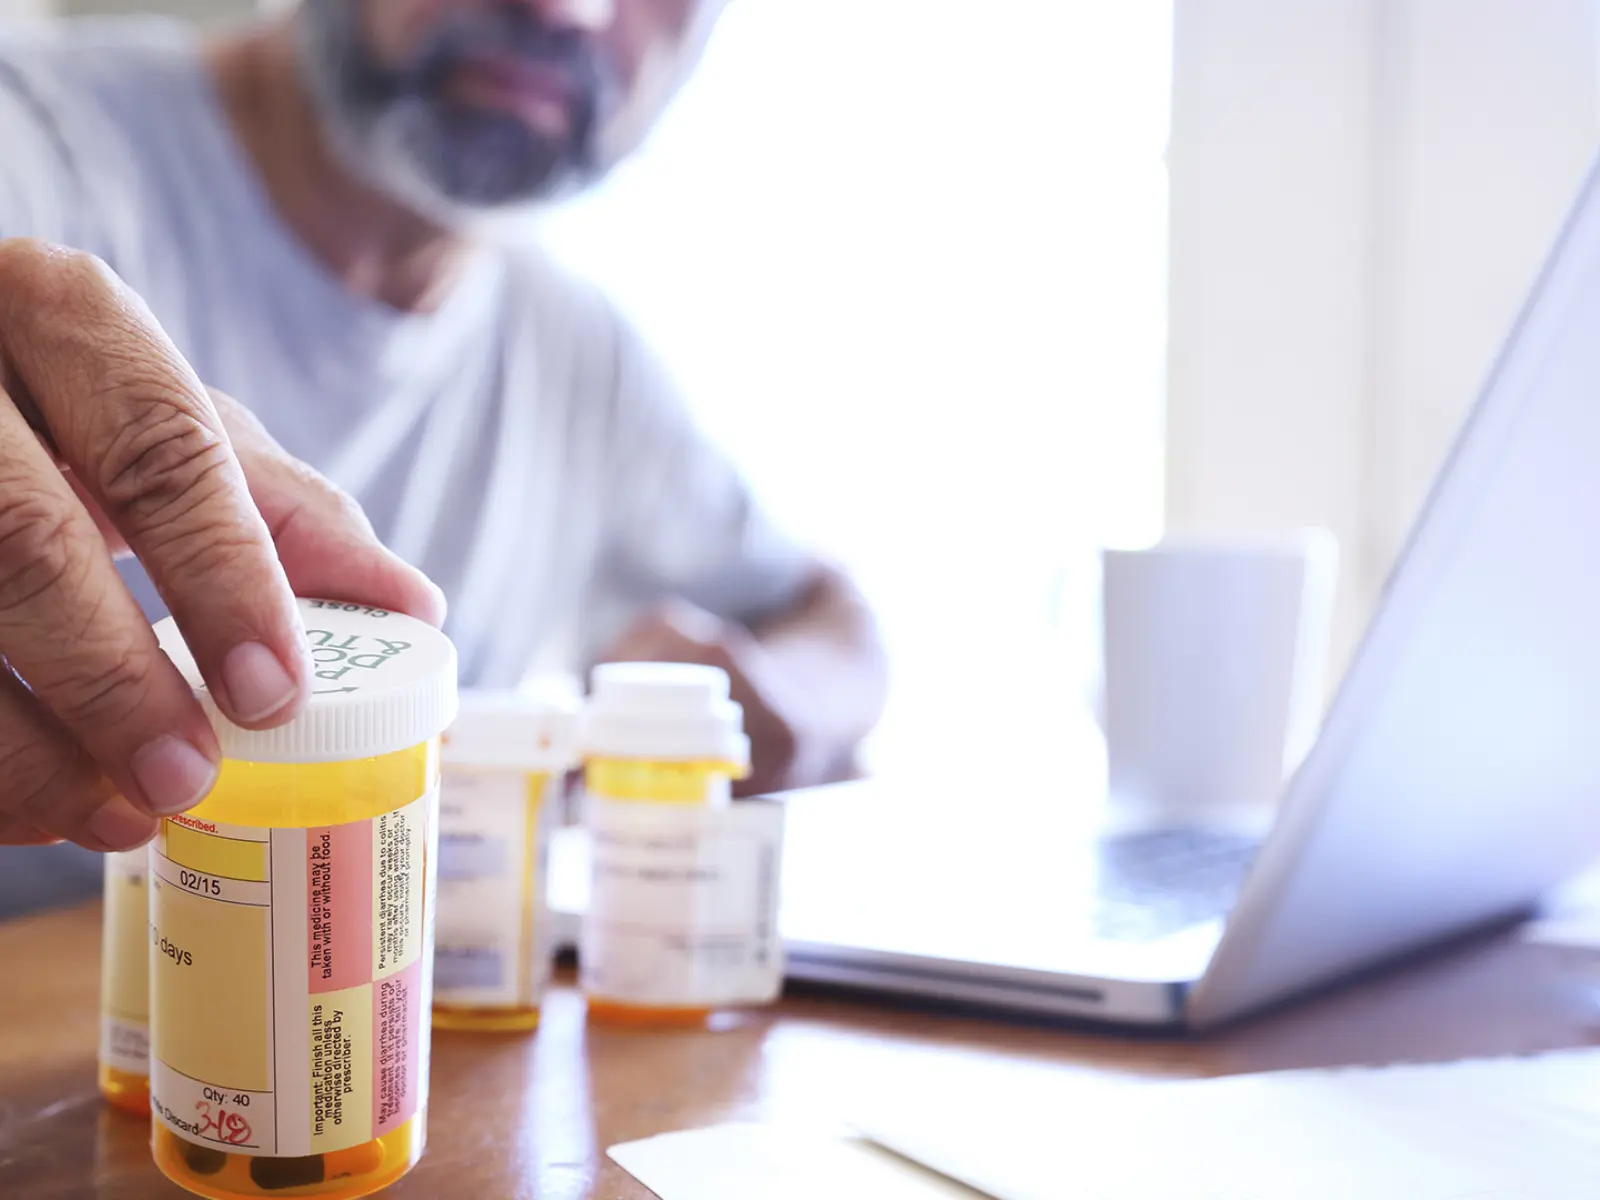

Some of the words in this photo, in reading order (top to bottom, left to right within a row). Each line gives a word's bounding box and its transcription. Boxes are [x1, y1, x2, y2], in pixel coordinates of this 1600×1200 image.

[309, 599, 389, 618] CLOSE
[305, 629, 361, 650] TU
[311, 647, 389, 669] DO
[379, 815, 387, 844] colitis
[310, 845, 320, 860] be
[320, 831, 331, 860] food.
[379, 847, 387, 858] to
[180, 870, 221, 895] 02/15
[311, 863, 323, 886] may
[320, 862, 331, 904] without
[379, 859, 387, 878] due
[322, 907, 331, 919] or
[379, 880, 387, 919] diarrhea
[310, 890, 321, 940] medicine
[321, 922, 332, 945] with
[378, 922, 387, 969] Persistent
[160, 936, 193, 966] days
[311, 944, 321, 968] This
[321, 948, 332, 979] taken
[379, 982, 391, 1018] during
[312, 1005, 322, 1026] this
[332, 1010, 343, 1023] by
[312, 1029, 322, 1041] all
[322, 1020, 332, 1057] unless
[332, 1027, 342, 1070] directed
[379, 1021, 388, 1065] diarrhea
[312, 1044, 324, 1078] Finish
[342, 1035, 353, 1093] prescriber.
[203, 1087, 228, 1105] Qty:
[232, 1094, 250, 1107] 40
[322, 1060, 333, 1118] medication
[332, 1073, 343, 1125] otherwise
[313, 1081, 325, 1136] Important:
[379, 1103, 389, 1124] May
